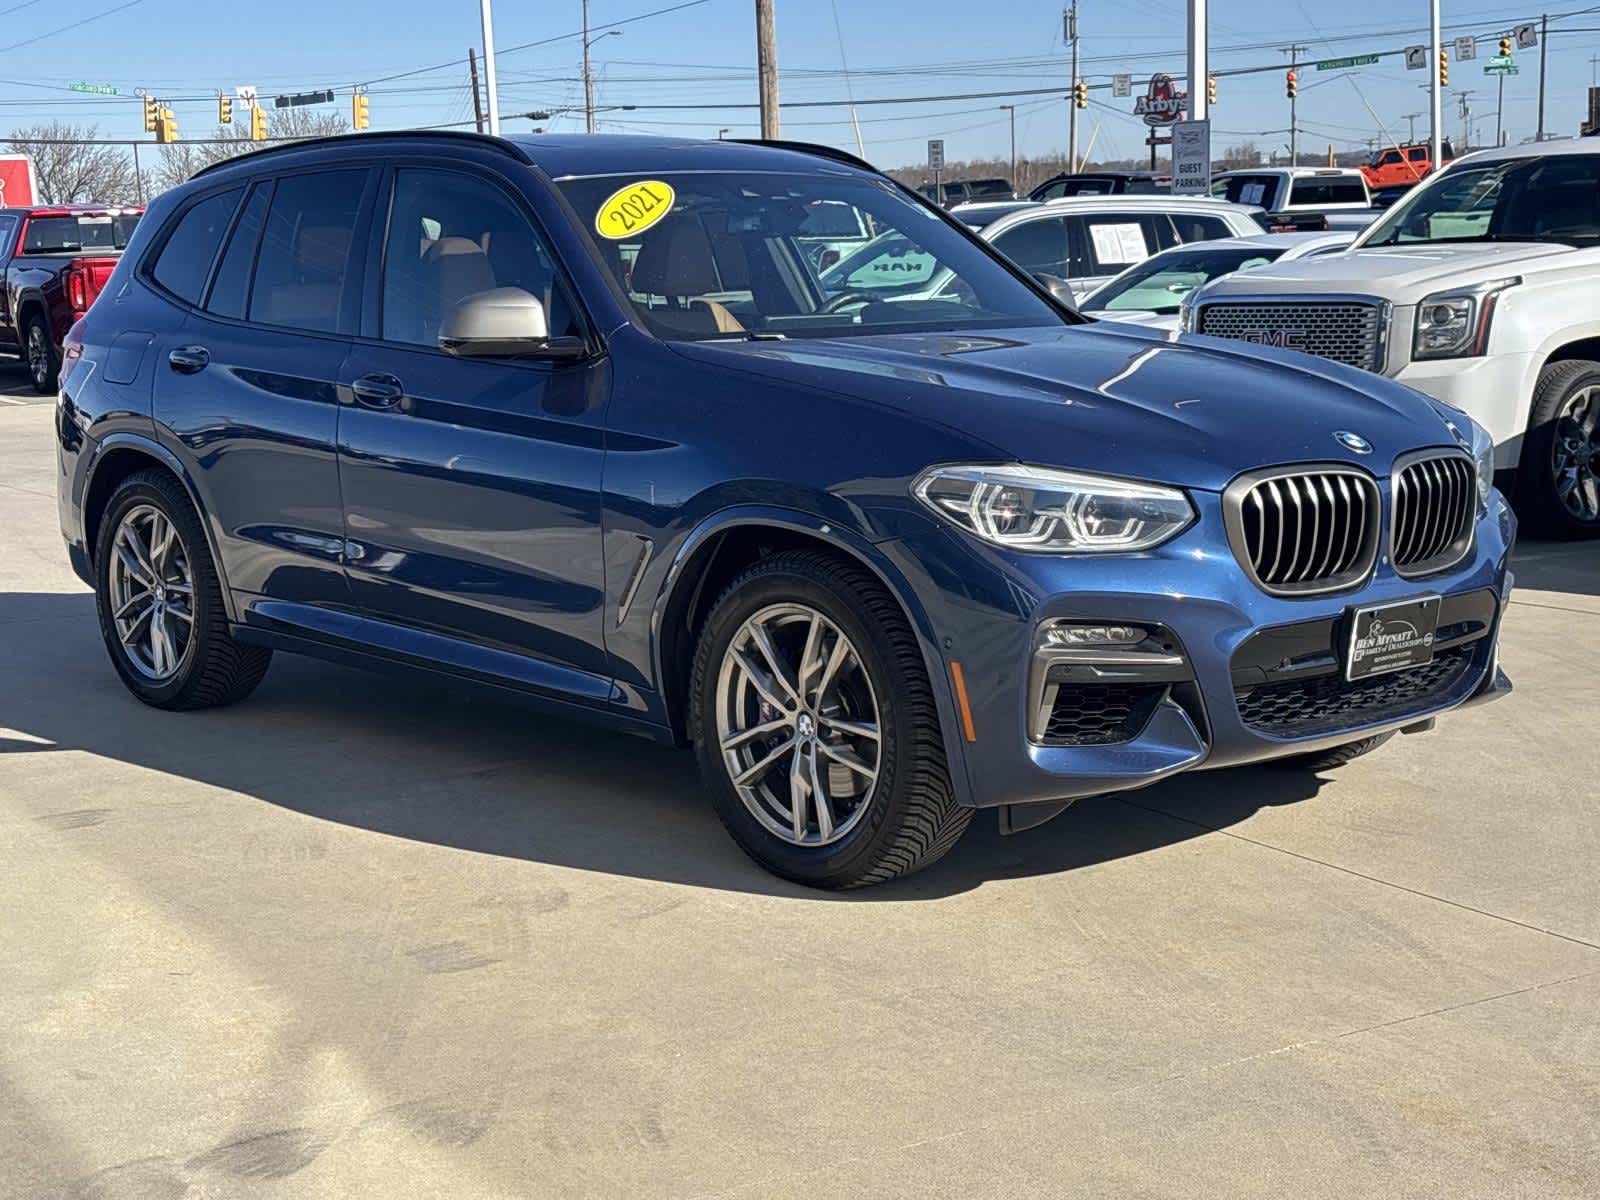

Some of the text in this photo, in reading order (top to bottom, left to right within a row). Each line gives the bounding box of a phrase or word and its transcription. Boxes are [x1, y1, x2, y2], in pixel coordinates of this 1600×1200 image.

[1179, 162, 1202, 173] GUEST
[1175, 178, 1206, 188] PARKING
[610, 186, 664, 230] 2021
[1242, 330, 1306, 351] GMC
